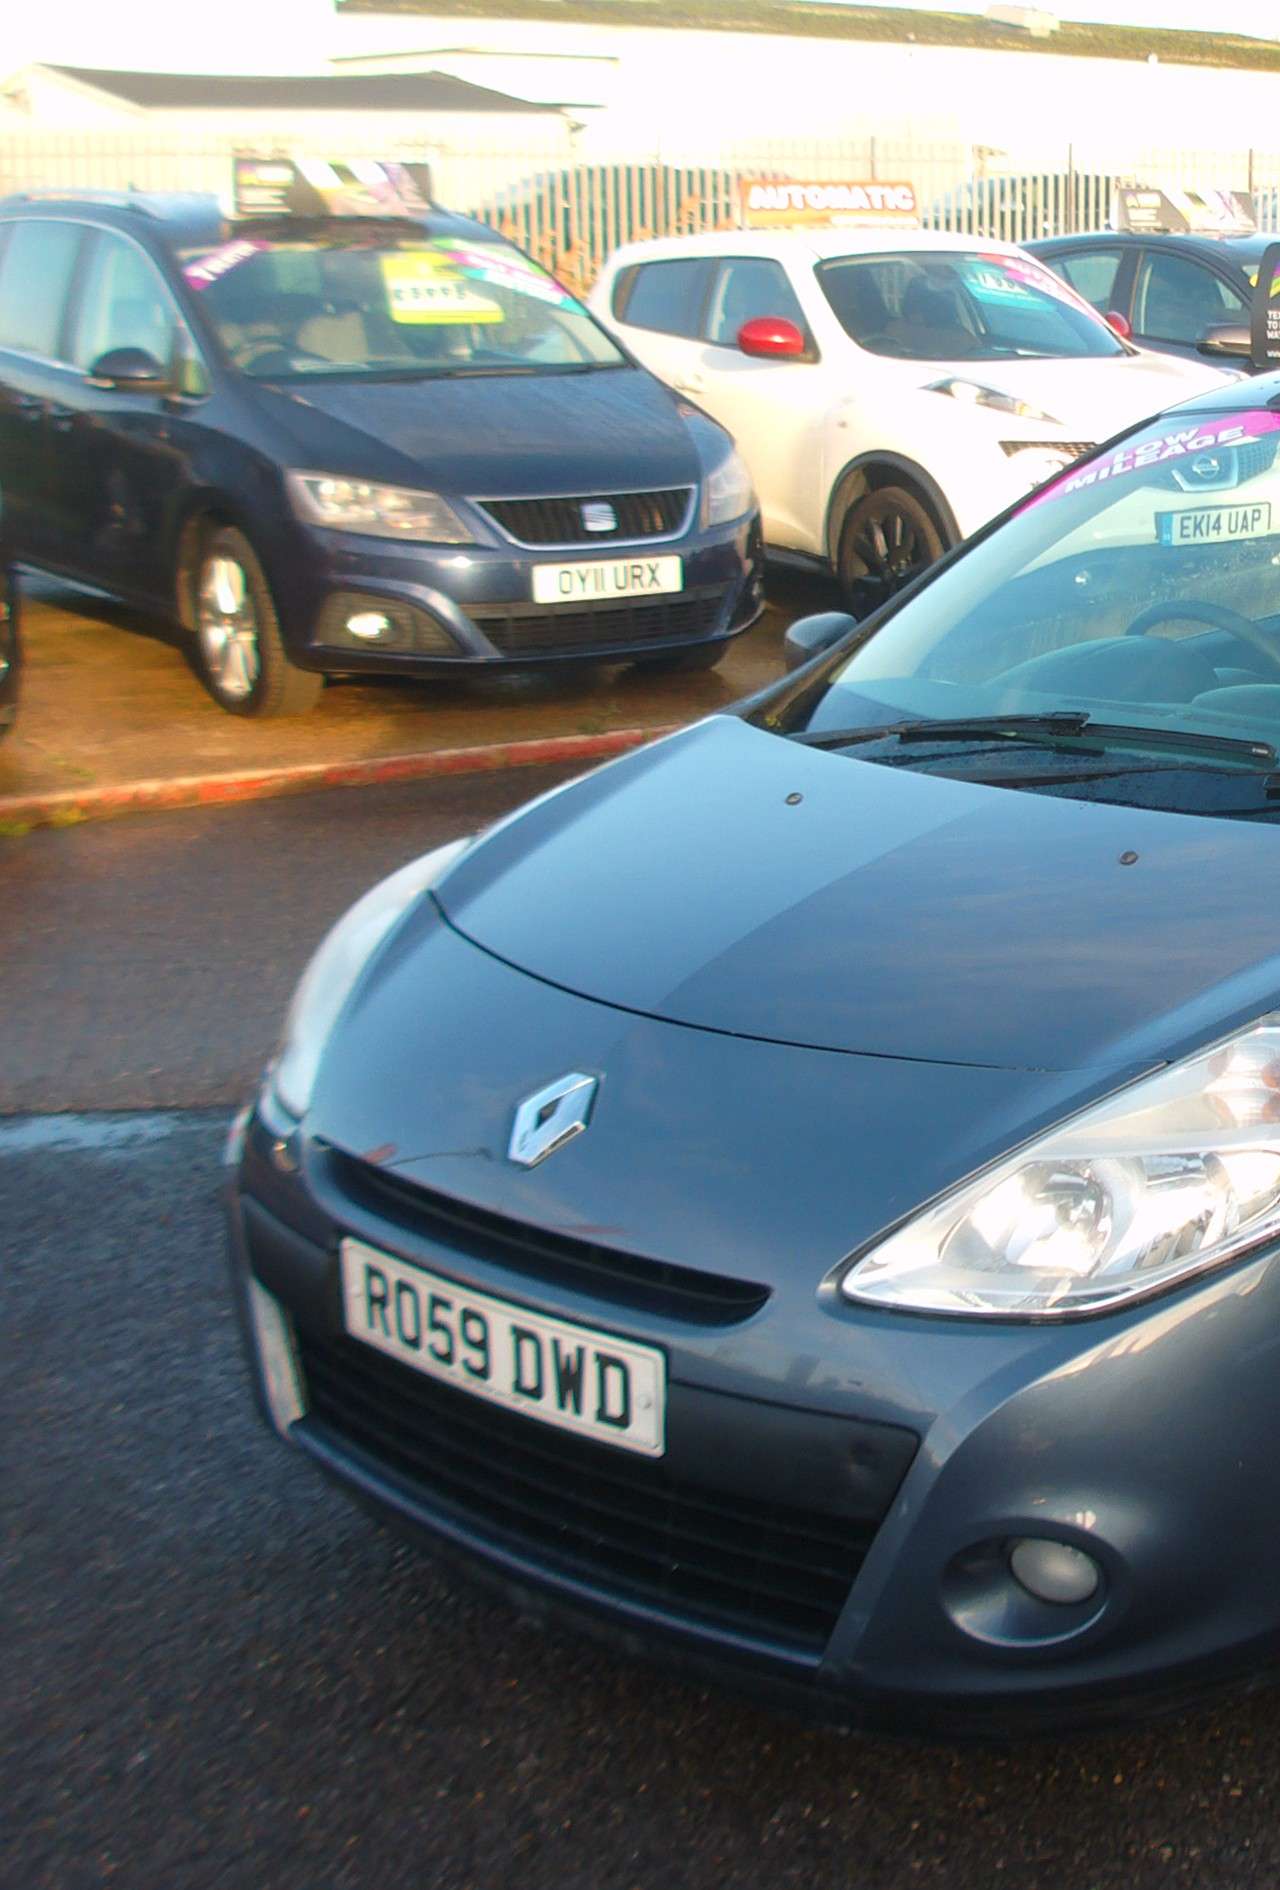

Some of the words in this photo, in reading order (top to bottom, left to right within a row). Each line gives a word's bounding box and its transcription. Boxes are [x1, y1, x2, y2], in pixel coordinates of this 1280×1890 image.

[750, 184, 916, 211] AUTOMATIC
[1267, 321, 1278, 330] TO
[1064, 426, 1245, 494] MILEAGE
[1113, 428, 1199, 466] LOW
[1180, 514, 1222, 539] EK14
[1228, 508, 1262, 534] UAP
[559, 568, 606, 595] OY11
[614, 562, 662, 590] URX
[364, 1262, 492, 1382] RO59
[511, 1324, 632, 1431] DWD
